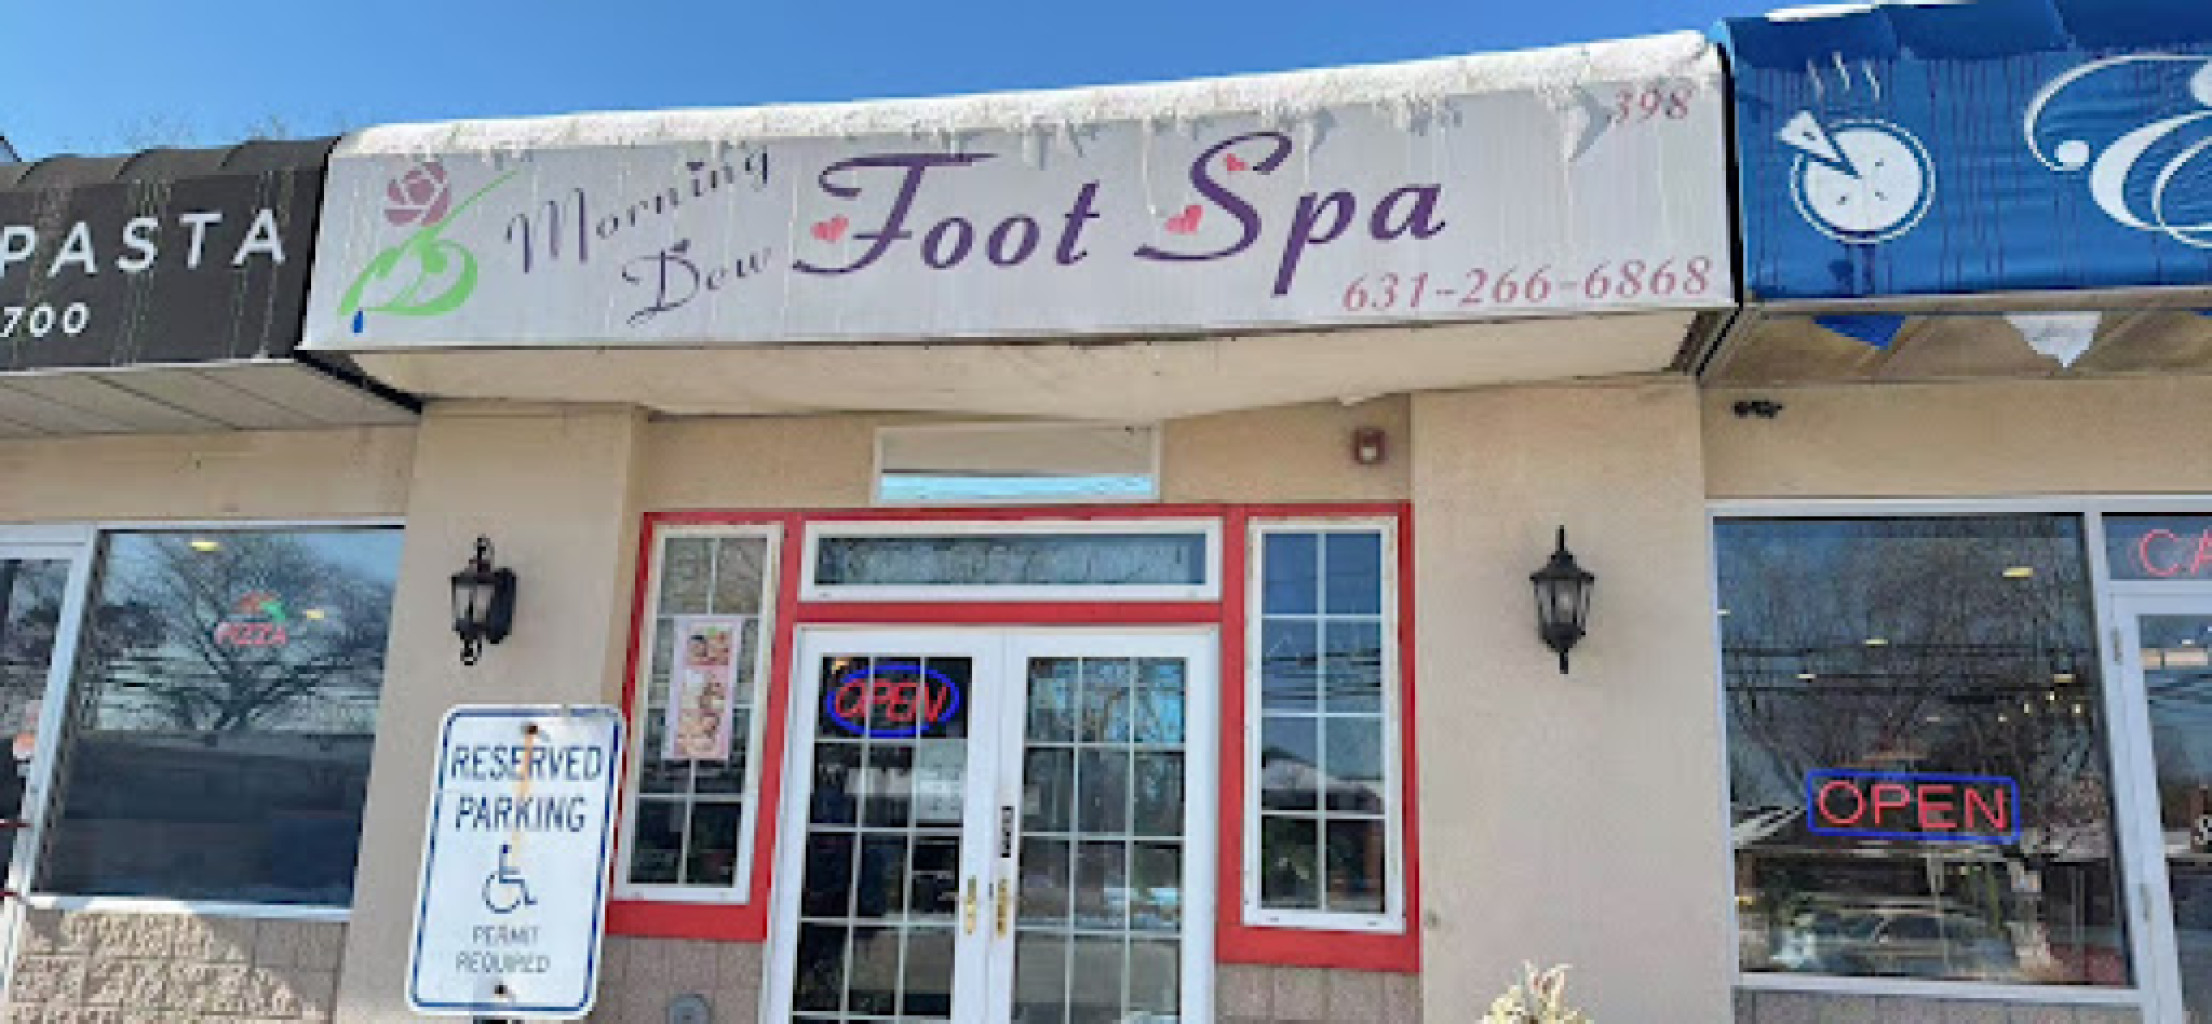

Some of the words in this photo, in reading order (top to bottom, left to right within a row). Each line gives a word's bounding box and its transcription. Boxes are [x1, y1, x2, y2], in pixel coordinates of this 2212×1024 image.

[1605, 81, 1695, 124] 398
[504, 147, 769, 273] Morning
[792, 152, 1100, 275] Foot
[1134, 131, 1446, 295] Spa
[0, 208, 286, 277] PASTA
[620, 245, 771, 328] Dew
[1342, 256, 1713, 311] 631-266-6868
[0, 302, 91, 338] 700
[214, 621, 288, 647] PIZZA
[835, 680, 948, 722] OPEN
[450, 745, 602, 782] RESERVED
[454, 796, 586, 832] PARKING
[1817, 780, 2008, 832] OPEN
[472, 924, 541, 946] PERMIT
[455, 951, 550, 974] REQUIRED
